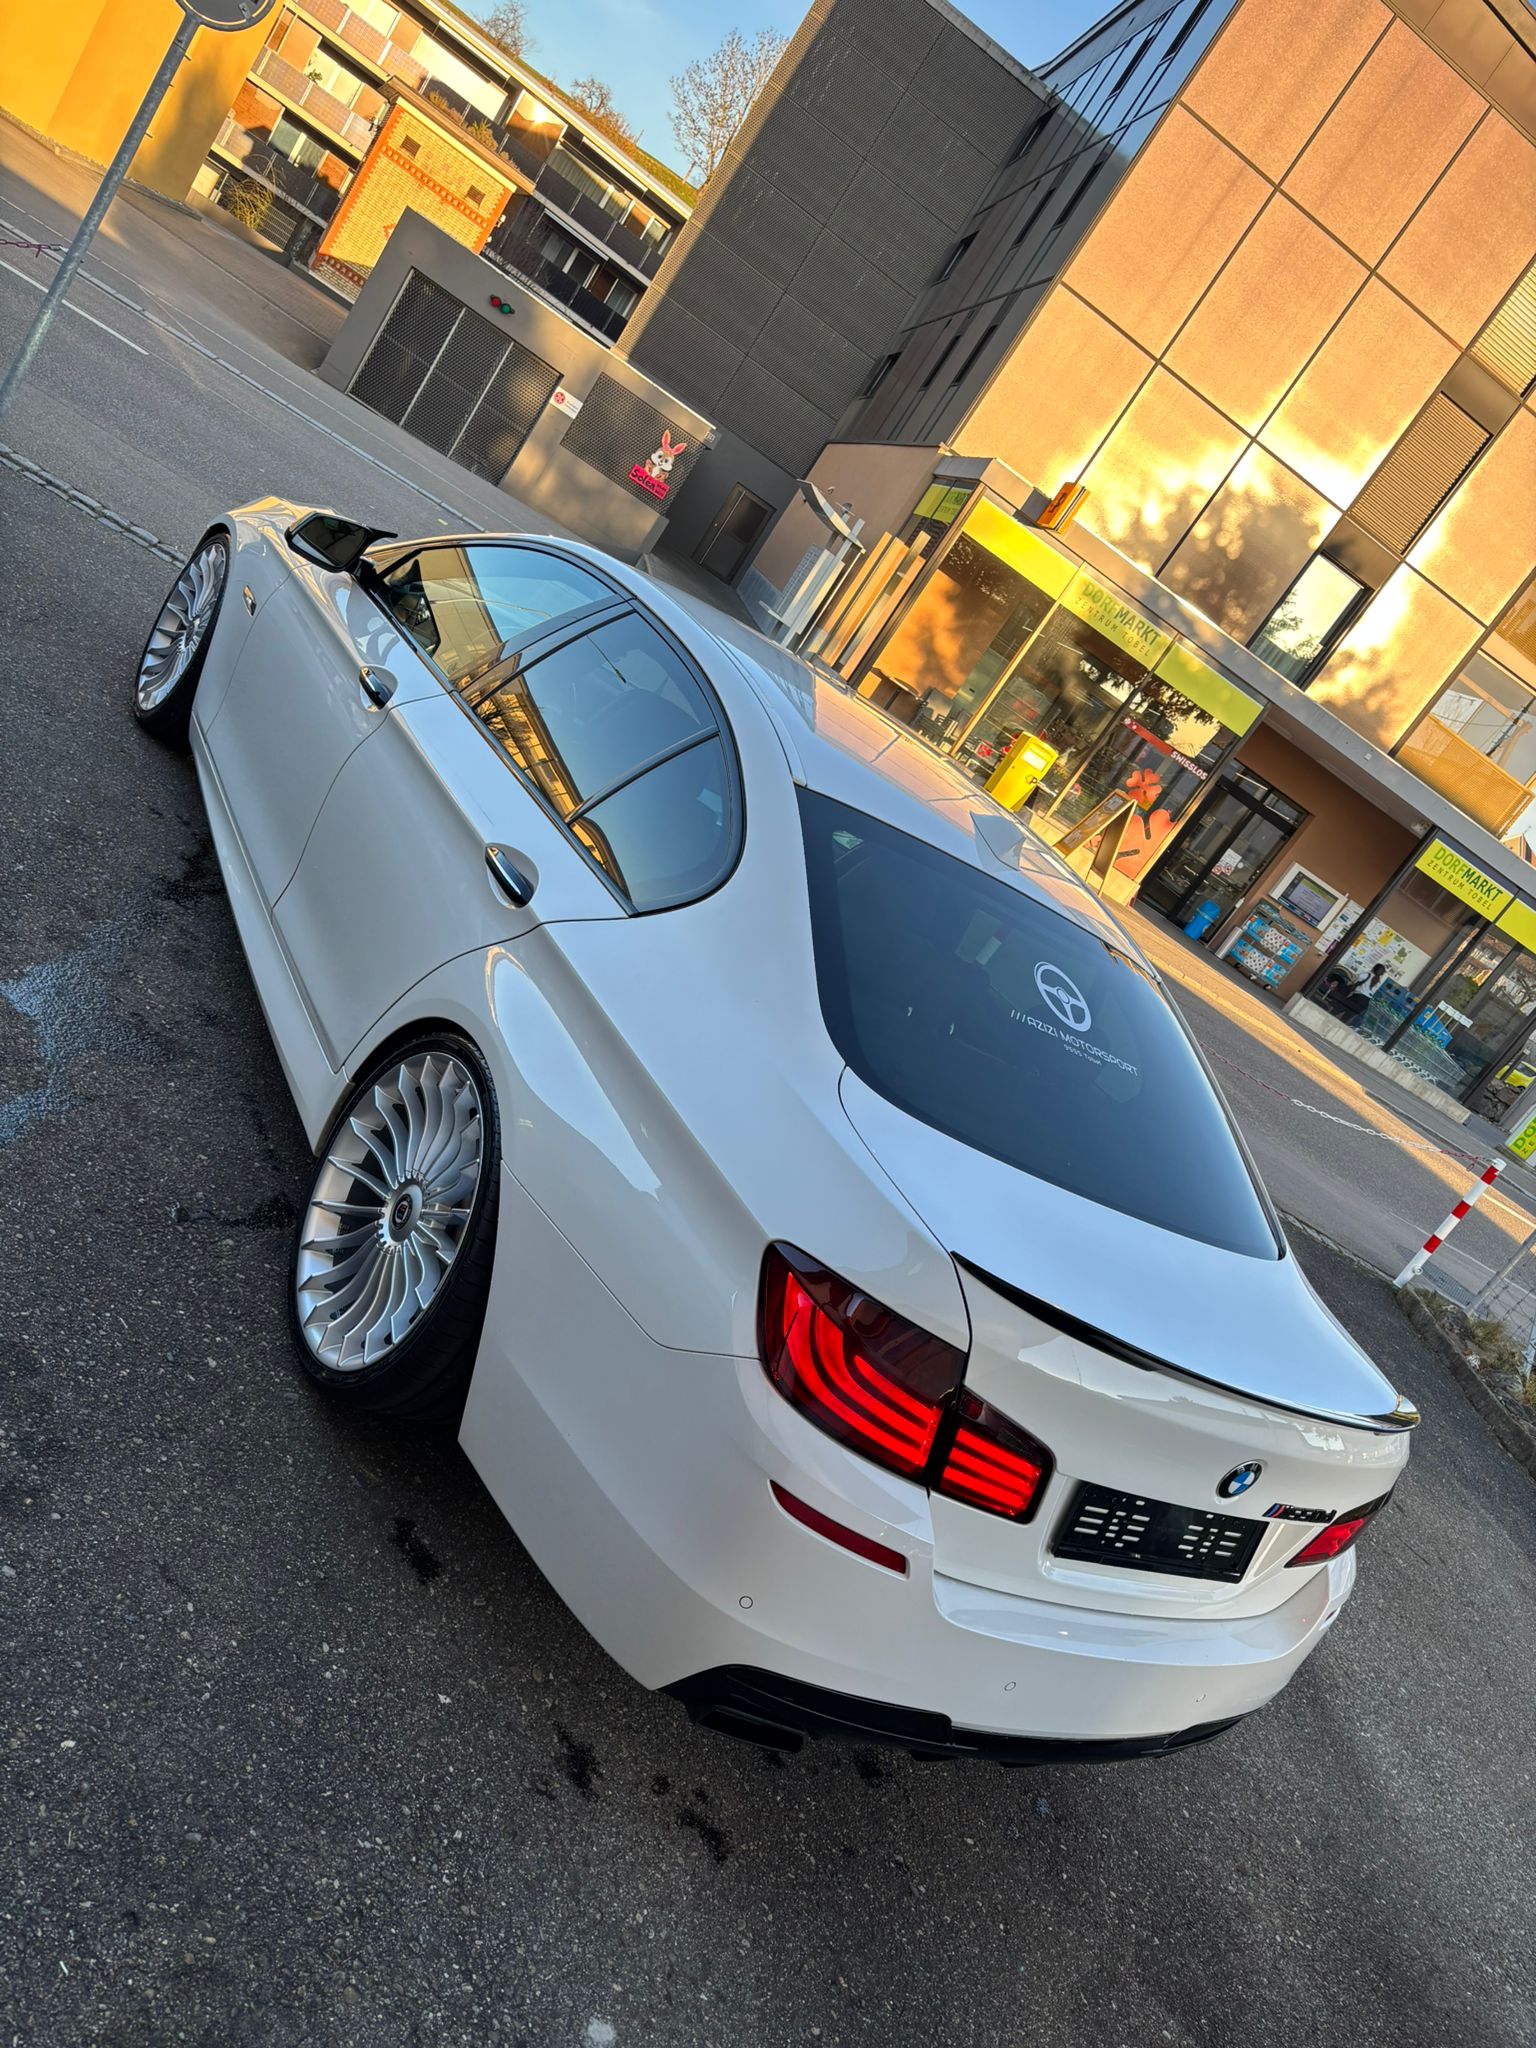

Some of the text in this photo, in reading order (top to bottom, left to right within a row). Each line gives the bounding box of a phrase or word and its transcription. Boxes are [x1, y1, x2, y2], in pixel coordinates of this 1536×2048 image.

[1075, 597, 1150, 657] ZENTRUM TOBEL
[1082, 582, 1161, 645] DORFMARKT
[1170, 750, 1208, 780] SWISSLOS
[1427, 859, 1492, 910] ZENTRUM TOBEL
[1434, 846, 1503, 902] DORFMARKT
[1060, 1030, 1138, 1077] MOTORSPORT
